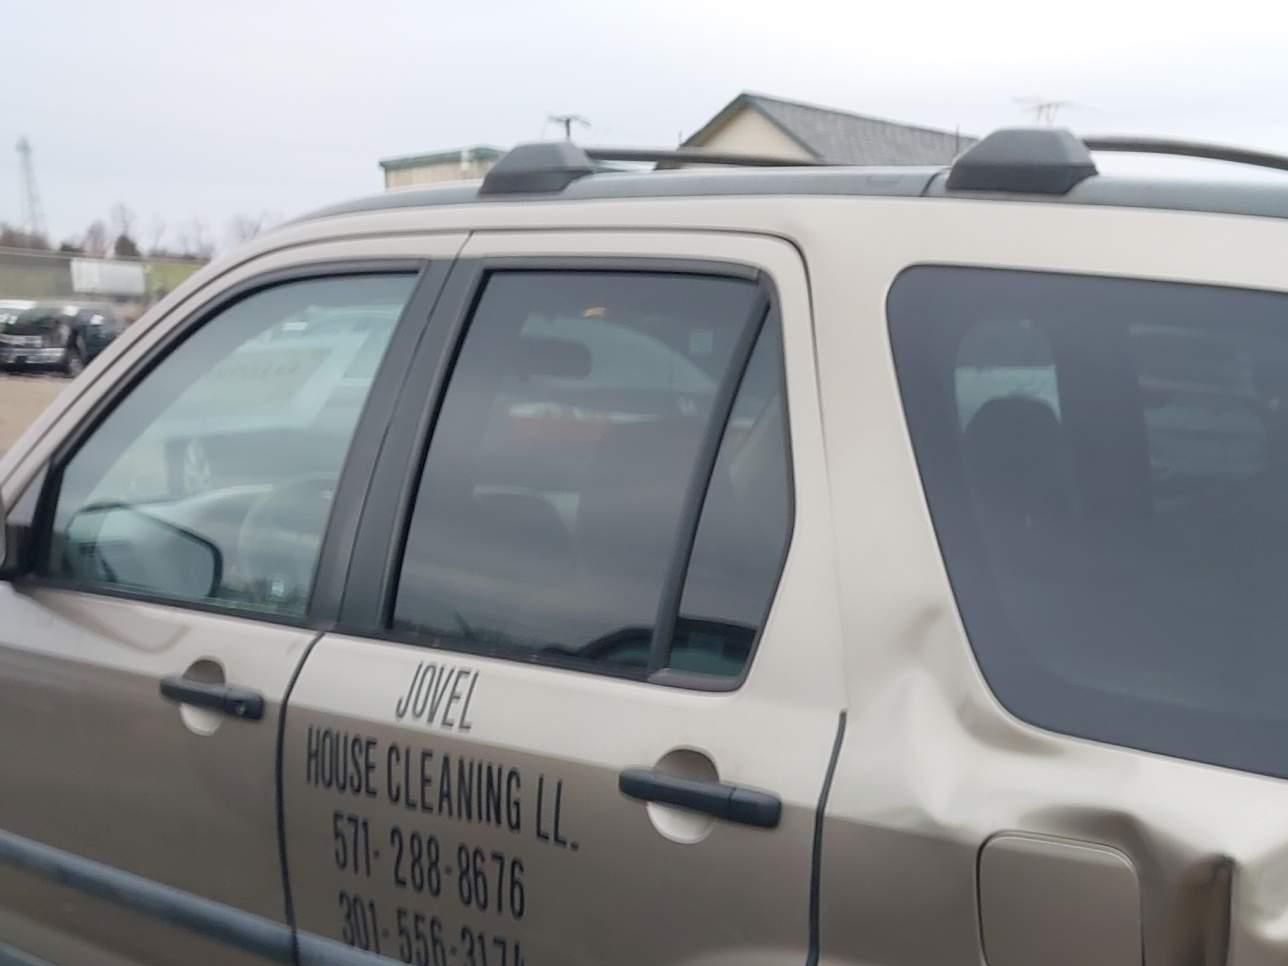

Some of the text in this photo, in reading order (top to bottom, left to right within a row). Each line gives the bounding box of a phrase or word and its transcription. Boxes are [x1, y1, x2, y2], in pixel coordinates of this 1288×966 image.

[396, 660, 481, 731] JOVEL
[306, 724, 378, 799] HOUSE
[387, 742, 521, 833] CLEANING
